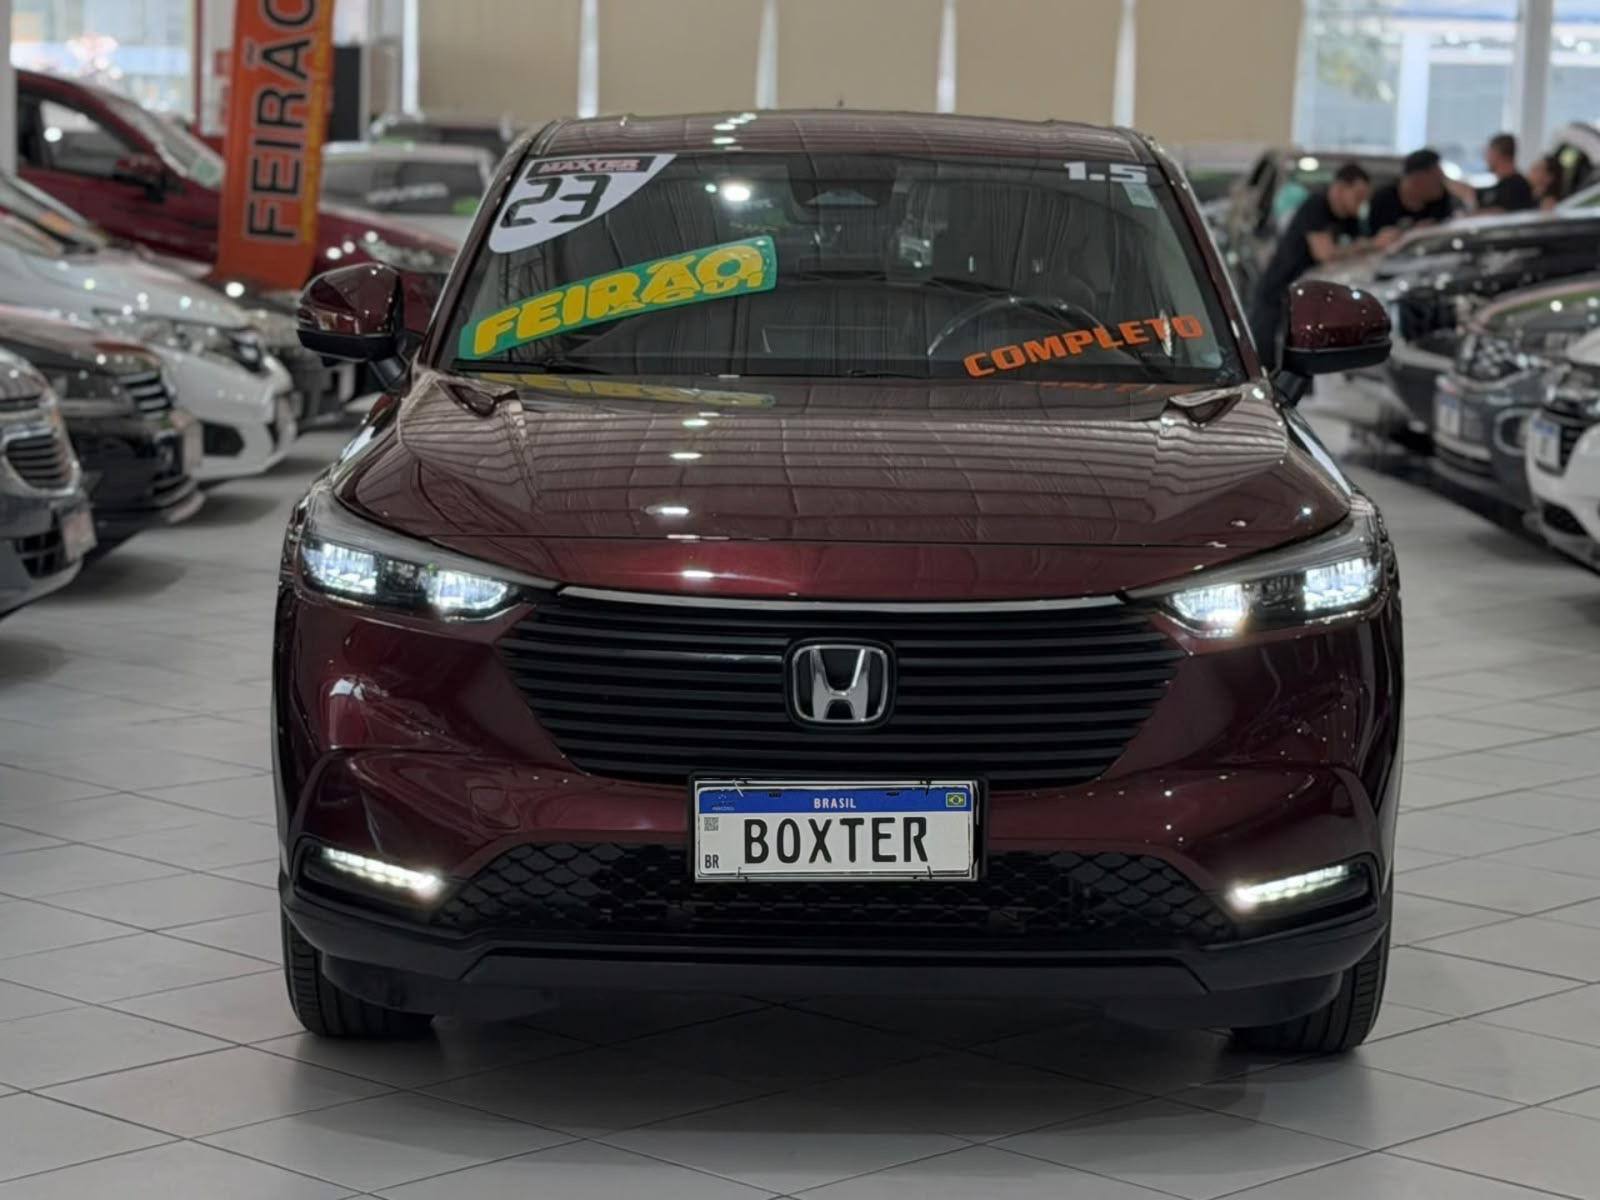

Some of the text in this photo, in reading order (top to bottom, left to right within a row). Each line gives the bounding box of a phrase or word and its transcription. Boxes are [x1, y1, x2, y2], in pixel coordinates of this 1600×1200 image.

[1064, 161, 1147, 183] 1.5
[500, 175, 612, 228] 23
[473, 244, 763, 356] FEIRÃO
[963, 315, 1204, 378] COMPLETO
[813, 797, 856, 809] BRASIL
[704, 854, 720, 869] BR
[744, 817, 928, 864] BOXTER
